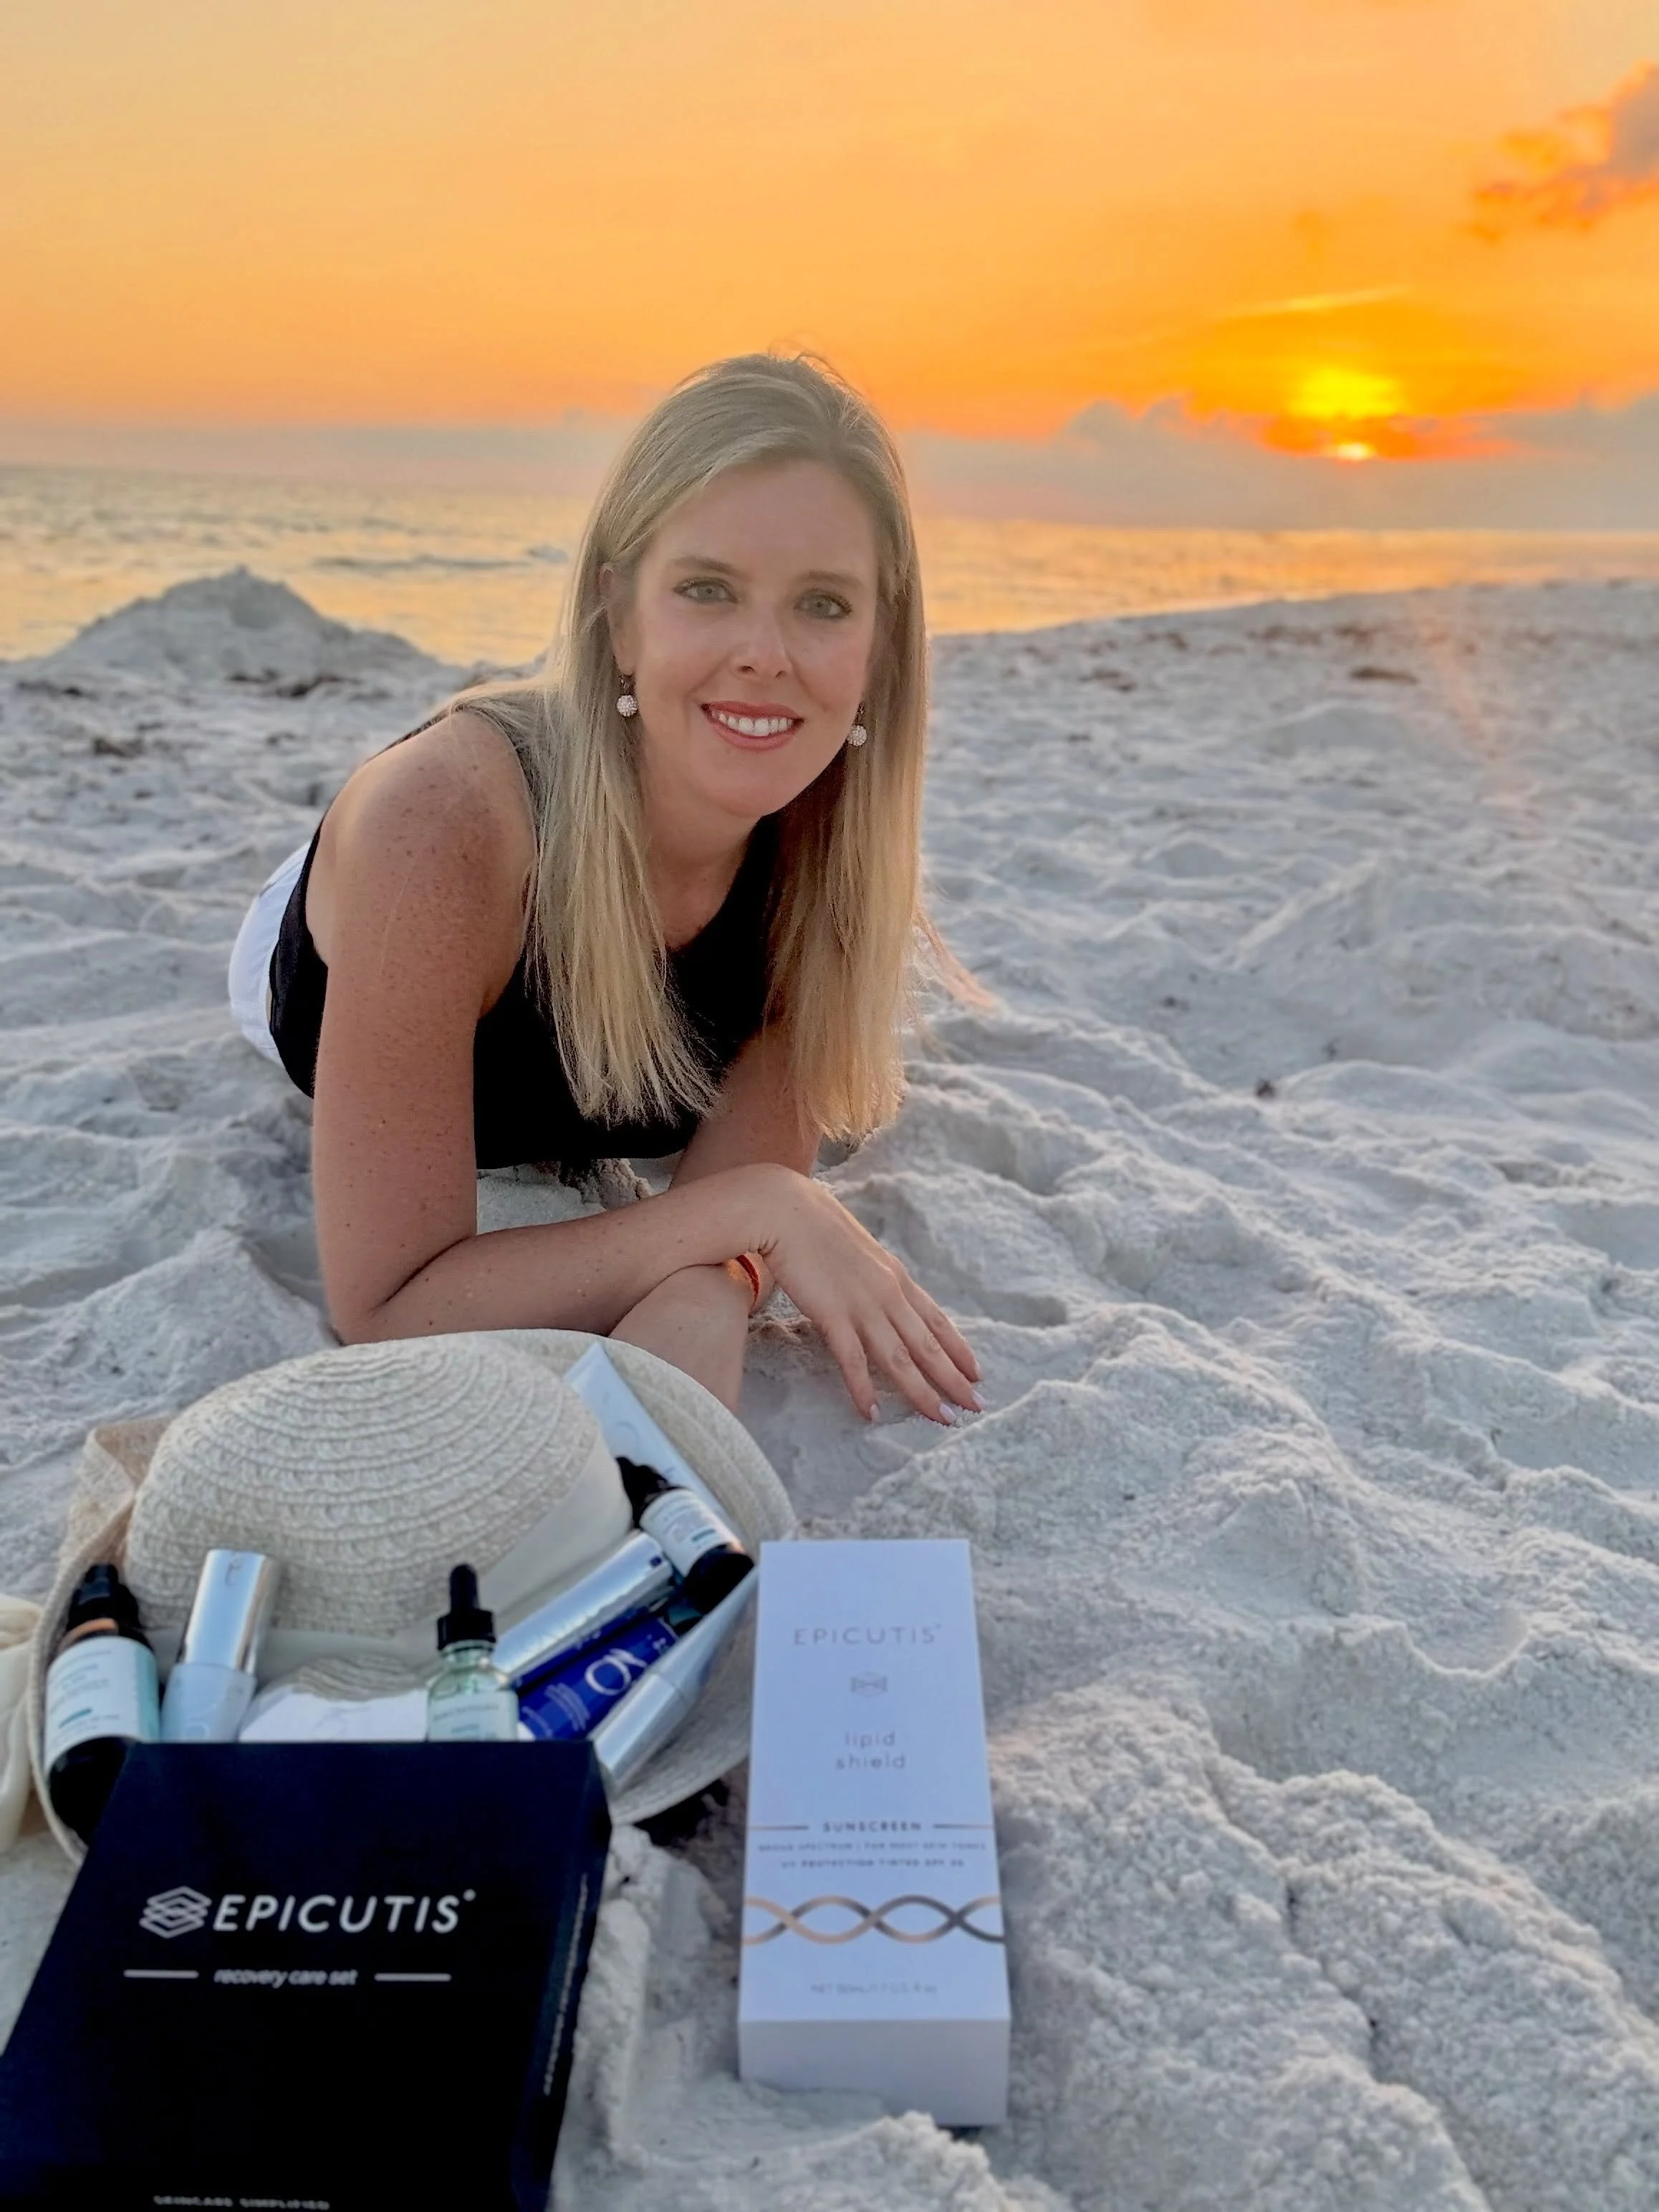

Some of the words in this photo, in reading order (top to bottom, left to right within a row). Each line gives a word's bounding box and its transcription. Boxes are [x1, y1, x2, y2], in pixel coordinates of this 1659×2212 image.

[793, 1627, 936, 1646] EPICUTIS
[845, 1731, 896, 1749] lipid
[835, 1754, 906, 1771] shield
[822, 1822, 922, 1833] SUNSCREEN
[213, 1895, 461, 1934] EPICUTIS
[213, 1968, 287, 1989] recovery
[288, 1970, 328, 1986] care
[327, 1968, 358, 1986] set
